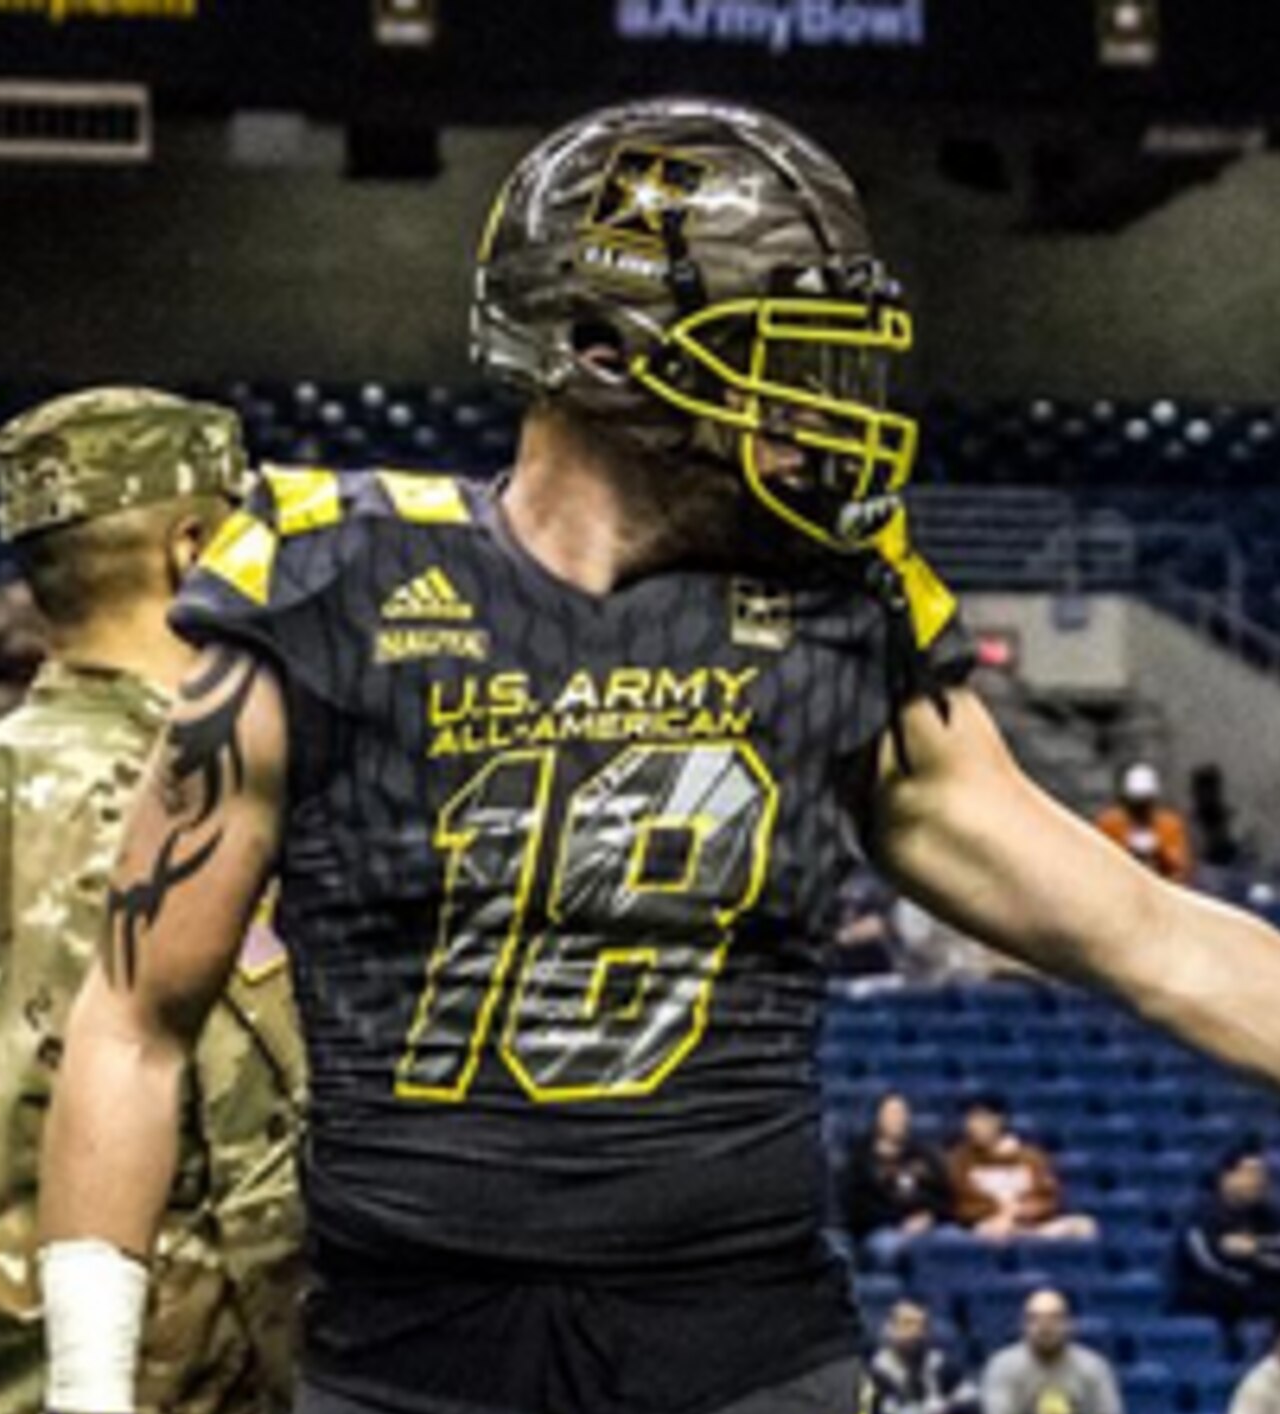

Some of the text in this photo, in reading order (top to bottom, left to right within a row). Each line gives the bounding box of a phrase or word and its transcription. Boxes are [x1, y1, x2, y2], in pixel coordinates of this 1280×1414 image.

[552, 666, 760, 713] ARMY
[425, 707, 754, 760] ALL-AMERICAN
[394, 740, 778, 1102] 18
